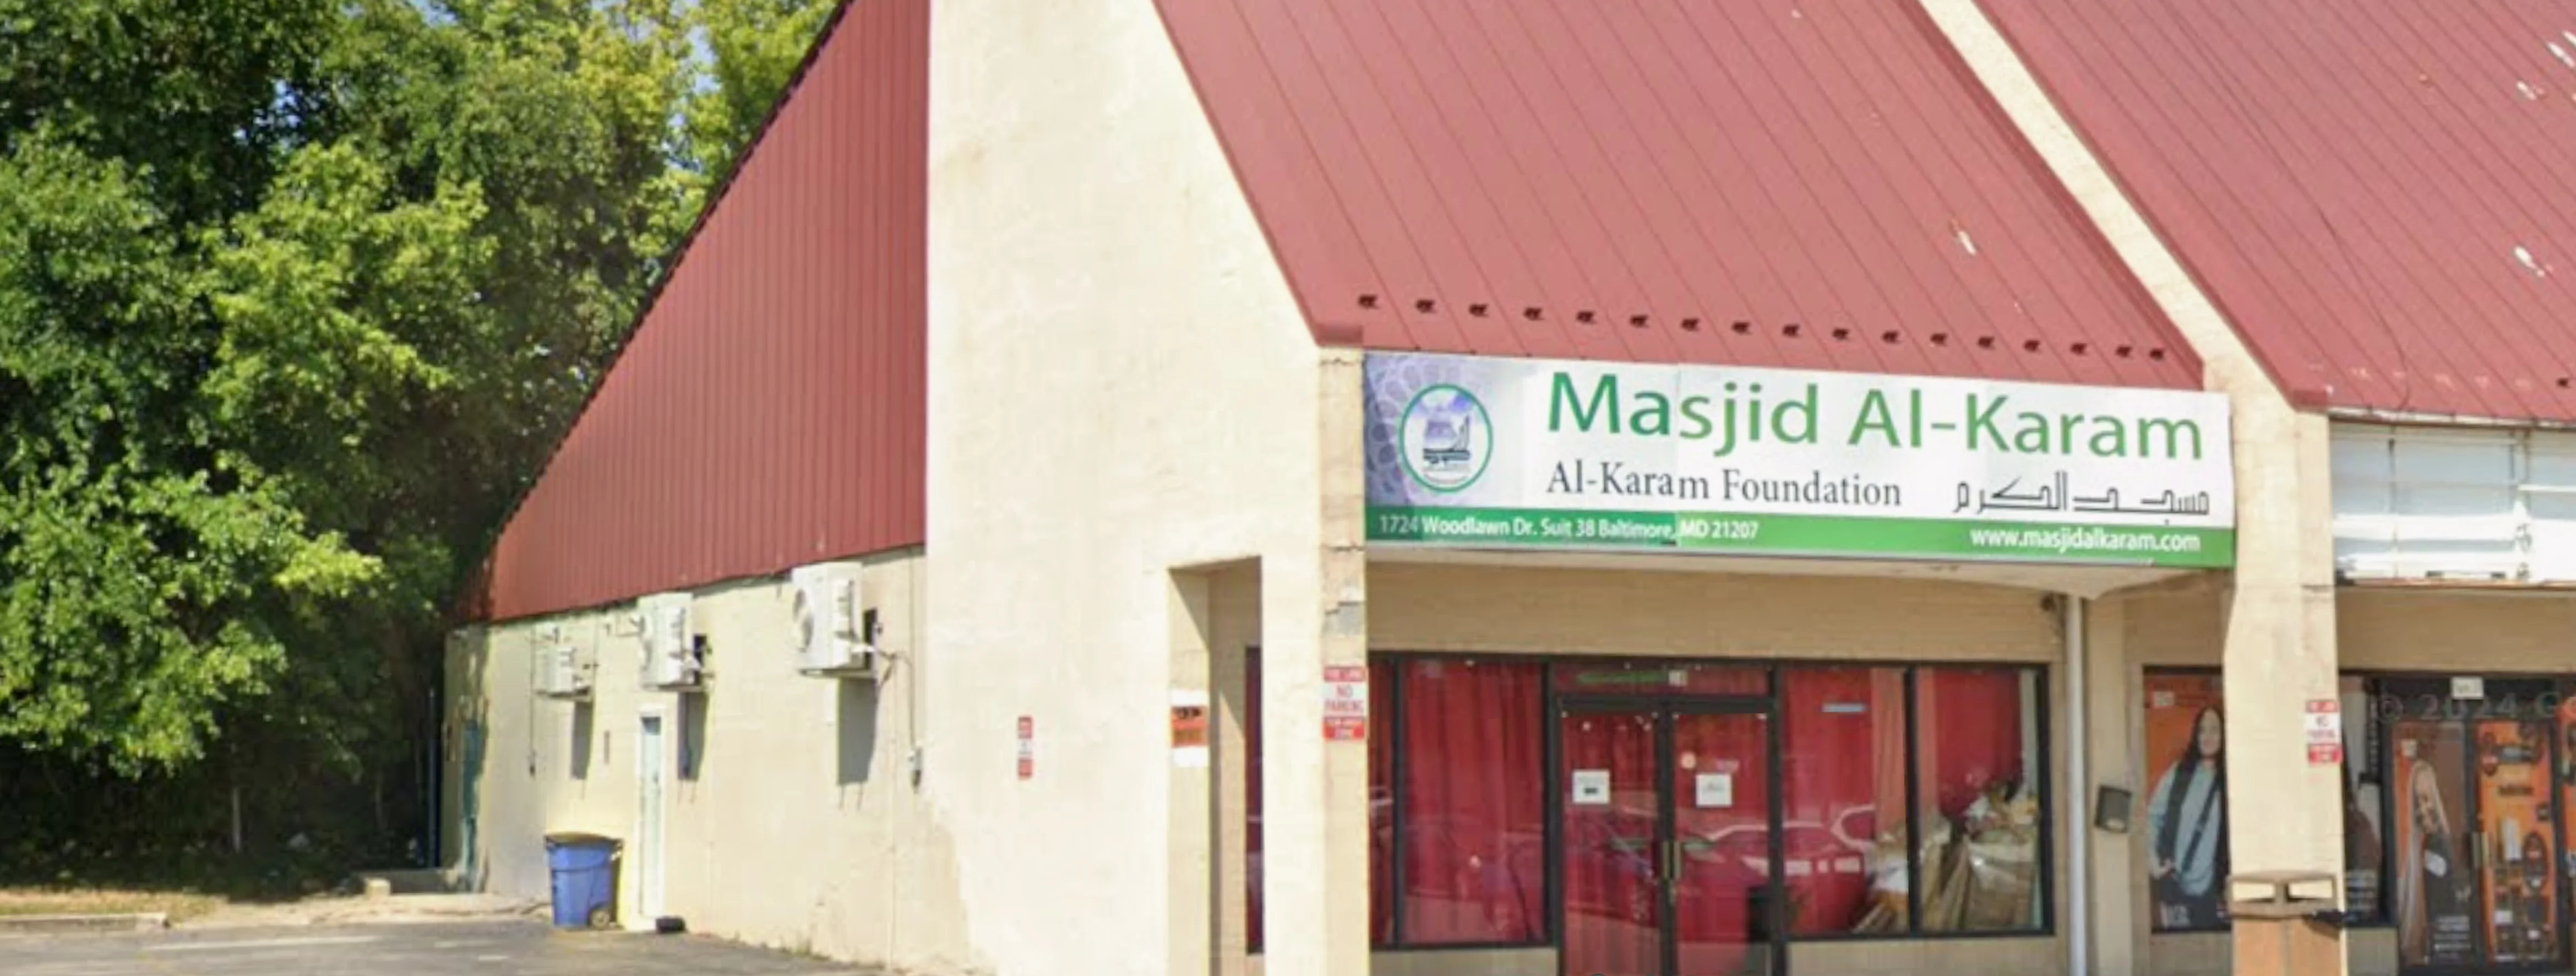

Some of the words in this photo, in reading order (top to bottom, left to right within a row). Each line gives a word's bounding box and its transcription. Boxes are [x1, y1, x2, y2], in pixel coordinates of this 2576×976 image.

[1548, 371, 1818, 457] Masjid
[1848, 388, 2203, 459] Al-Karam
[1546, 459, 1709, 500] Al-Karam
[1722, 468, 1901, 507] Foundation
[1379, 516, 1418, 534] 1724
[1422, 515, 1510, 535] Woodlawn
[1513, 517, 1537, 536] Dr.
[1576, 519, 1595, 537] 38
[1599, 519, 1676, 539] Baltimore,
[1679, 520, 1708, 538] MD
[1711, 520, 1758, 539] 21207
[1970, 527, 2200, 554] www.masjidalkaram.com
